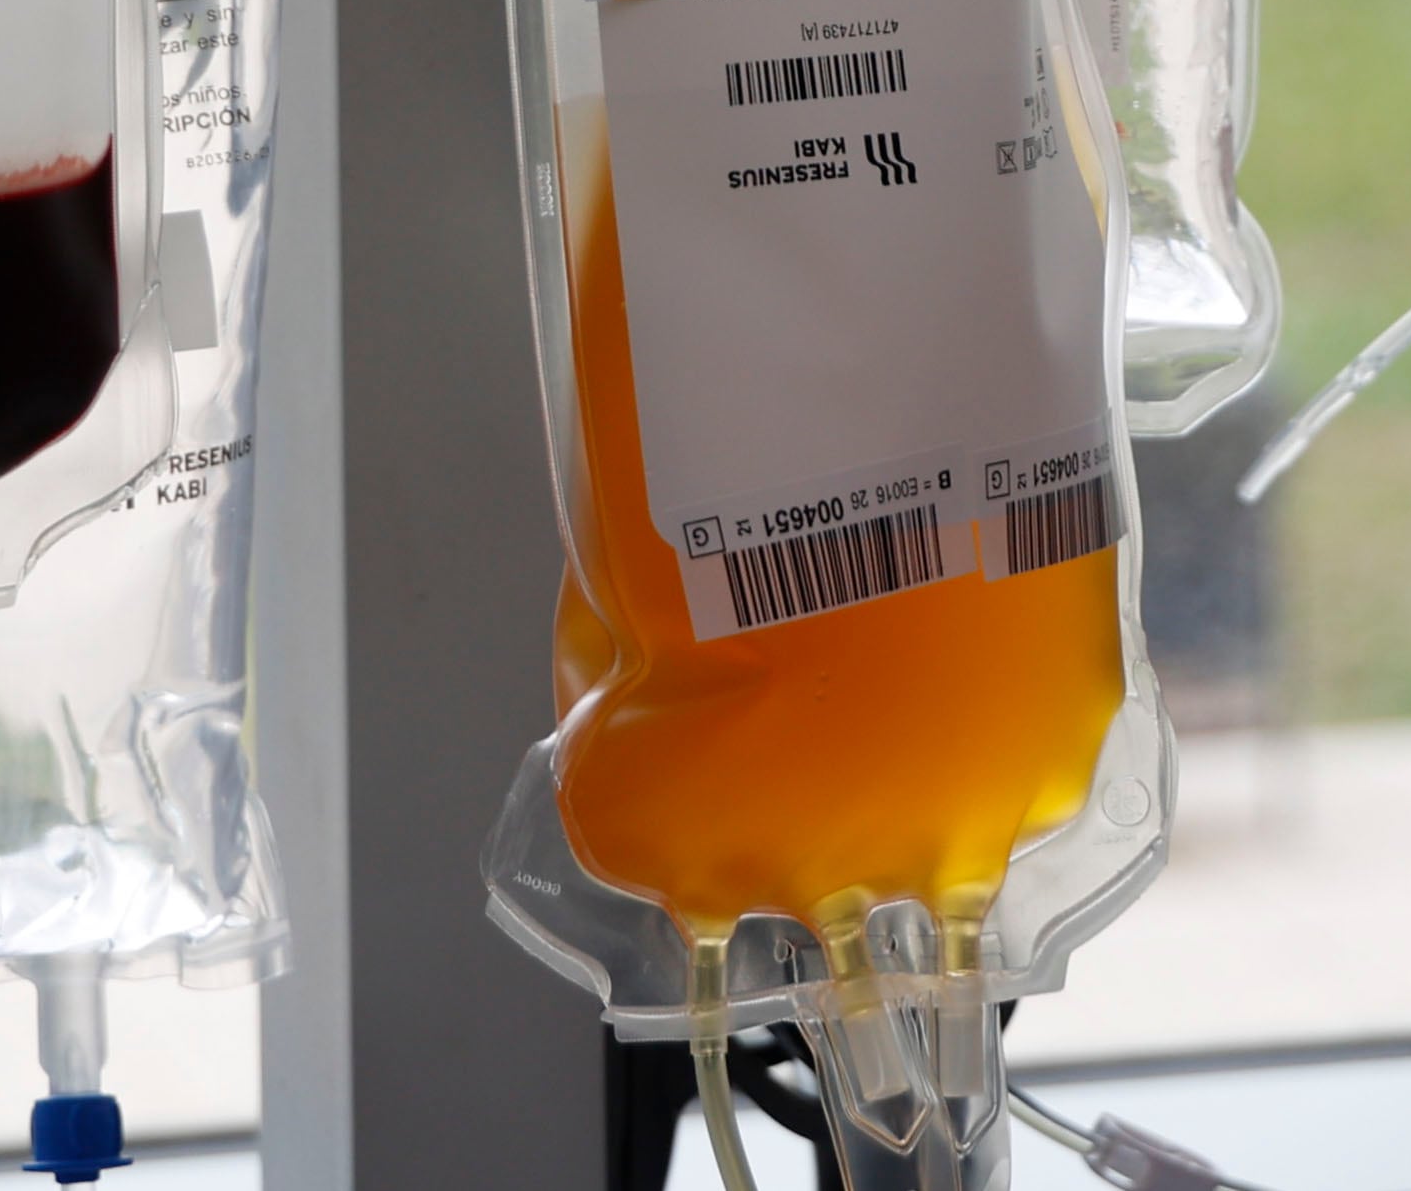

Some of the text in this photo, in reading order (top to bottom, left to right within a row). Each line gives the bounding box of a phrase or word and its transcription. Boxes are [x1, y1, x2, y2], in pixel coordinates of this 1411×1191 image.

[184, 12, 195, 29] y
[206, 8, 235, 24] sin
[800, 19, 899, 41] 471717439 [A]
[159, 32, 240, 56] zar este
[162, 105, 252, 133] RIPCIÓN
[793, 137, 847, 158] KABI
[727, 160, 849, 189] FRESENIUS
[168, 433, 253, 475] RESENIUS
[937, 469, 952, 490] B
[1033, 452, 1079, 488] 004651
[156, 478, 208, 505] KABI
[850, 488, 869, 510] 26
[875, 476, 919, 504] E0016
[761, 496, 845, 538] 004651
[691, 526, 711, 549] G
